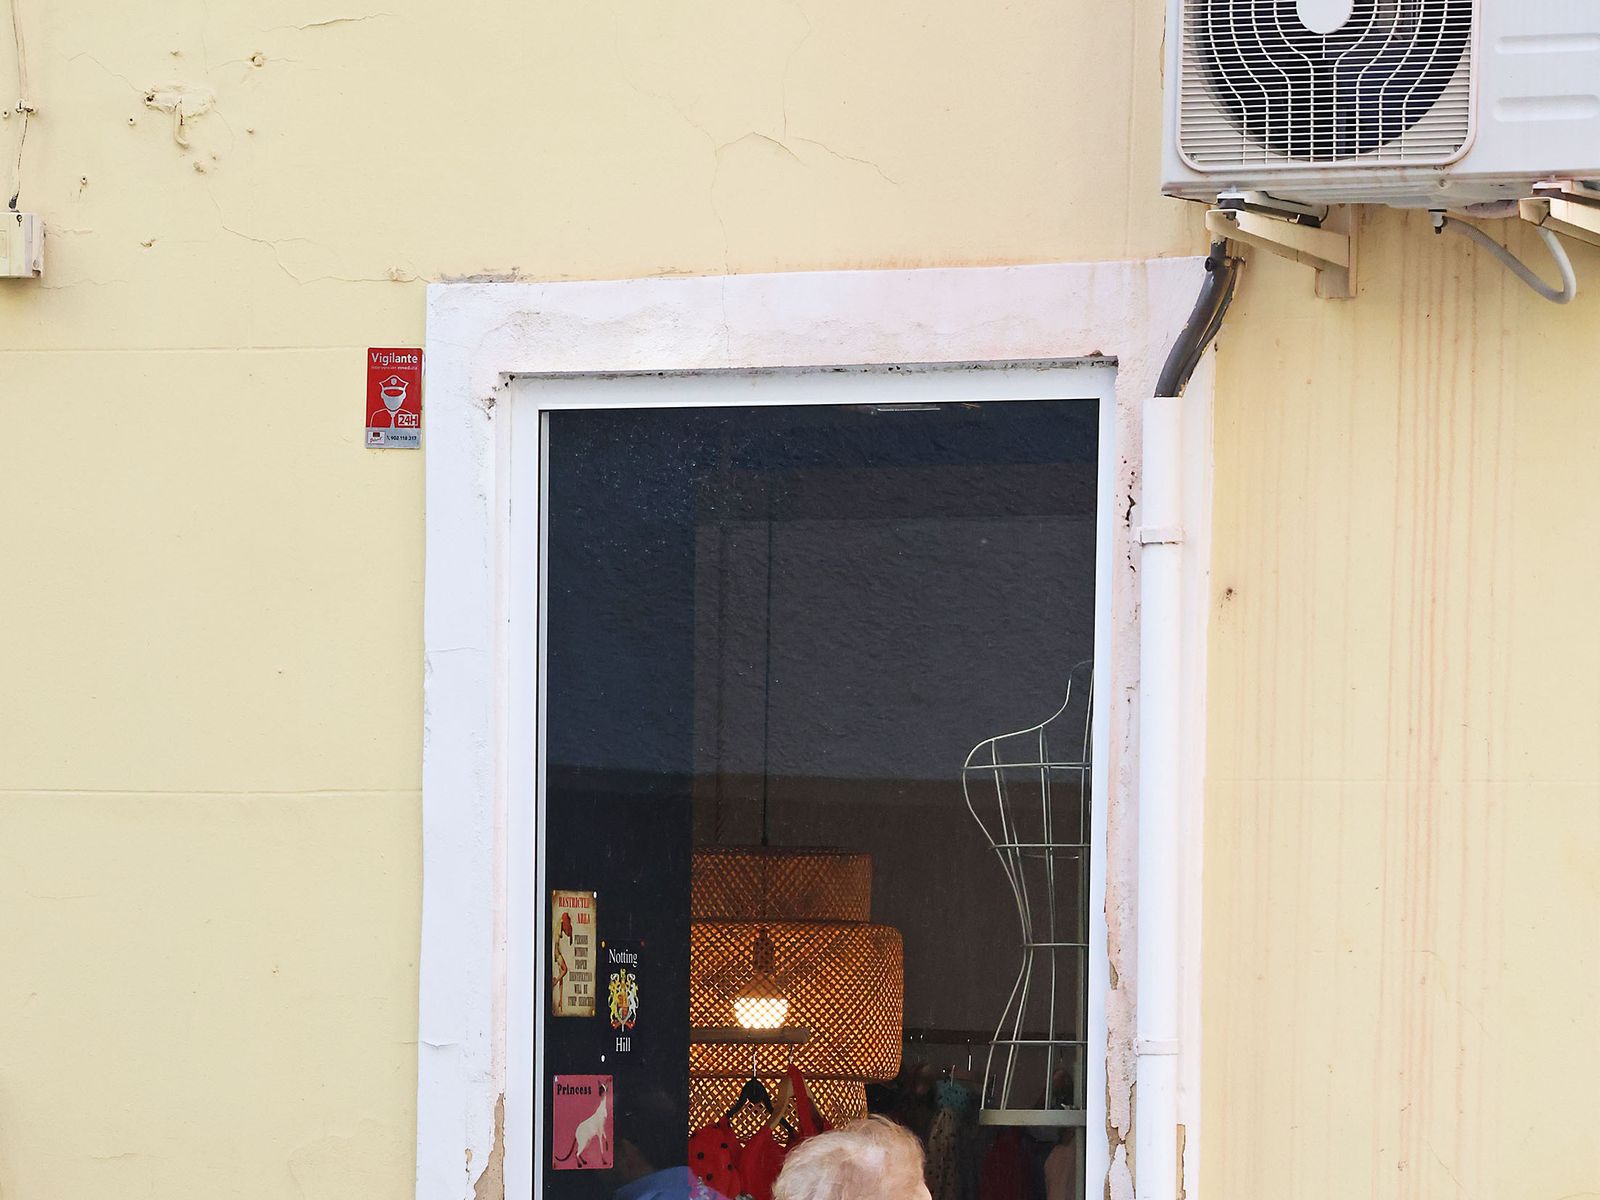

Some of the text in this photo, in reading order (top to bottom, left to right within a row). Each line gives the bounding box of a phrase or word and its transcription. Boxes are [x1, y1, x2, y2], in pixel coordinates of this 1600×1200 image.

[371, 352, 418, 366] Vigilante
[398, 415, 417, 425] 24H
[608, 949, 638, 967] Notting
[615, 1037, 631, 1052] Hill
[557, 1084, 592, 1095] Princess
